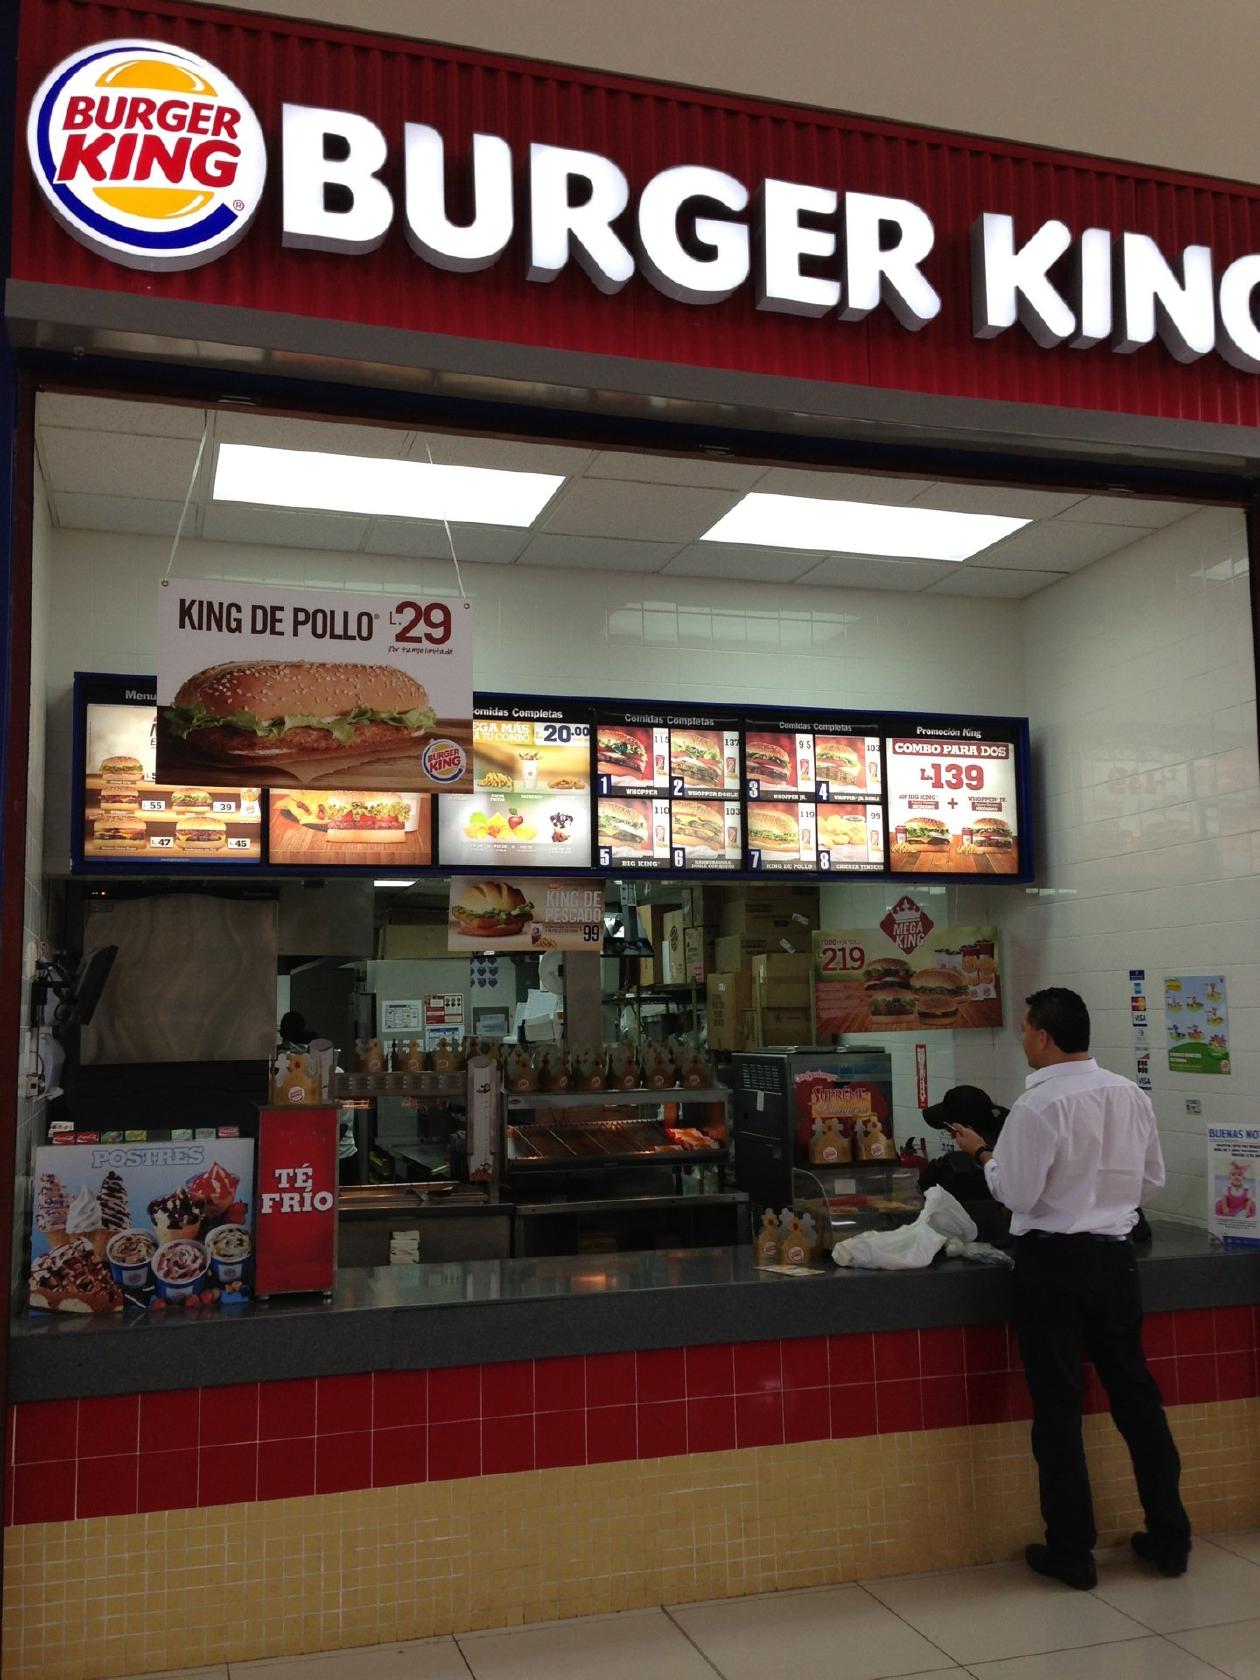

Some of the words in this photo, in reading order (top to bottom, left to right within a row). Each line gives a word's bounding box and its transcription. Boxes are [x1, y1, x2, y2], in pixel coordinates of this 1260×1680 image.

[62, 96, 241, 140] BURGER
[57, 133, 241, 188] KING
[282, 103, 940, 322] BURGER
[179, 598, 242, 633] KING
[251, 604, 285, 636] DE
[293, 607, 373, 641] POLLO
[473, 707, 509, 717] omidas
[512, 708, 564, 719] Completas
[625, 714, 664, 725] Comidas
[667, 716, 715, 726] Completas
[779, 721, 811, 730] Comidas
[813, 723, 852, 732] Completas
[916, 726, 960, 737] Promoción
[962, 727, 983, 739] King
[428, 748, 460, 763] BURGER
[895, 742, 940, 754] COMBO
[943, 744, 978, 756] PARA
[980, 745, 1007, 757] DOS
[429, 756, 461, 773] KING
[600, 776, 607, 794] 1
[674, 779, 683, 796] 2
[749, 780, 758, 798] 3
[819, 783, 828, 800] 4
[149, 802, 162, 810] 55
[219, 803, 232, 811] 39
[158, 838, 171, 846] 47
[235, 840, 247, 848] 45
[600, 848, 610, 866] 5
[674, 849, 684, 867] 6
[751, 850, 759, 868] 7
[820, 852, 829, 870] 8
[546, 890, 579, 907] KING
[583, 890, 602, 907] DE
[544, 907, 602, 923] PESCADO
[583, 924, 600, 942] 99
[893, 921, 923, 935] MEGA
[896, 933, 926, 949] KING
[1209, 1128, 1243, 1139] BUENAS
[92, 1146, 205, 1169] POSTRES
[275, 1162, 313, 1188] TÉ
[261, 1186, 334, 1214] FRÍO
